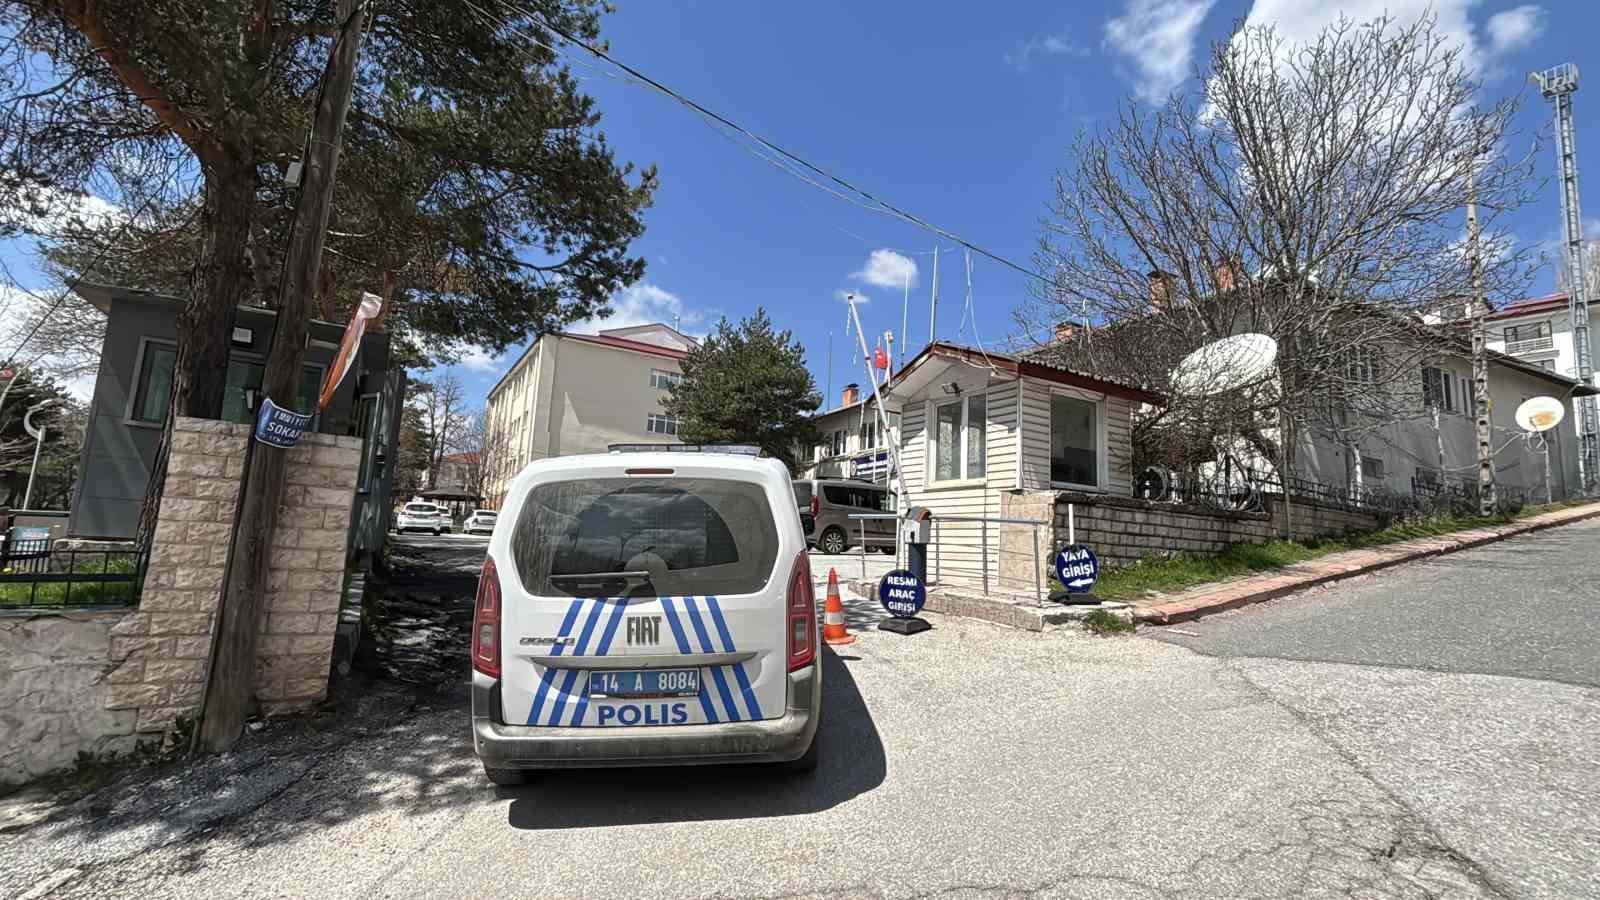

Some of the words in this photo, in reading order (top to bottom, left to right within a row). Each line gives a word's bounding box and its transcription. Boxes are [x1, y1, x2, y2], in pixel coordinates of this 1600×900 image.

[1061, 549, 1090, 562] YAYA
[626, 616, 662, 646] FIAT
[602, 674, 619, 691] 14
[634, 673, 643, 691] A
[658, 671, 697, 690] 8084
[598, 703, 688, 725] POLIS
